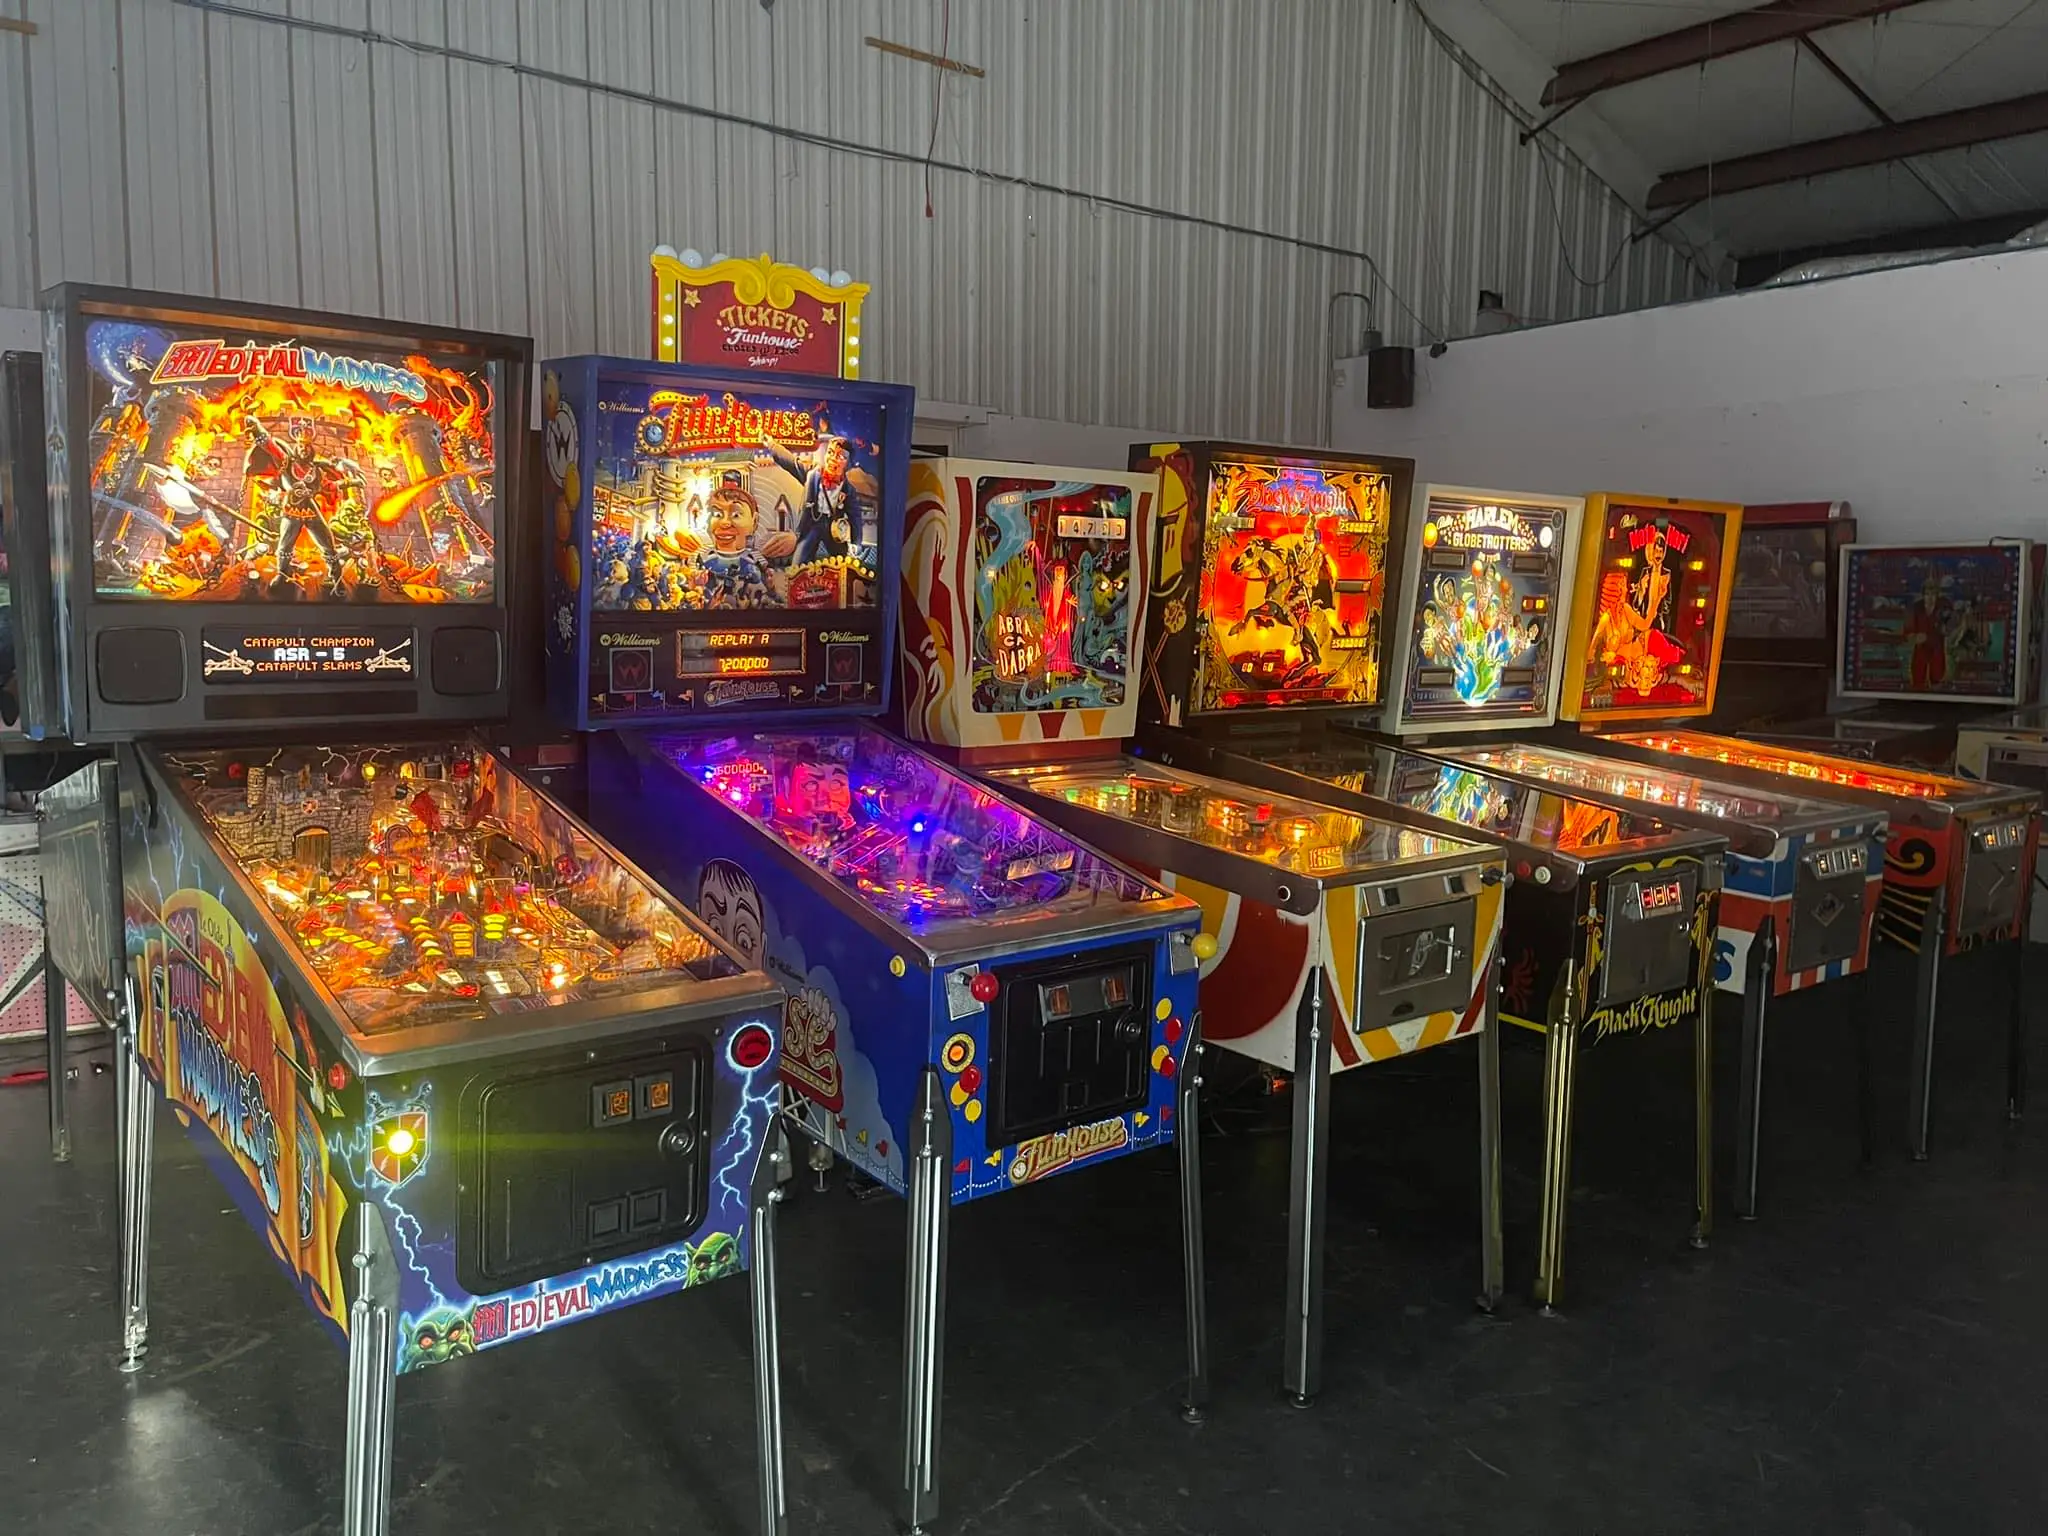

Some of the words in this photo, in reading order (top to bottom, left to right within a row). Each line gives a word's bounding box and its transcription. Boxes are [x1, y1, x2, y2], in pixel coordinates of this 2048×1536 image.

[720, 305, 808, 338] TICKETS
[151, 338, 307, 384] MEDIEVAL
[301, 346, 427, 401] MADNESS
[1465, 506, 1519, 536] HARLEM
[998, 614, 1033, 637] ABRA
[243, 637, 306, 647] CATAPULT
[311, 637, 375, 647] CHAMPION
[612, 633, 661, 647] Williams
[710, 634, 754, 646] REPLAY
[829, 630, 869, 643] Williams
[1003, 635, 1026, 647] CA
[256, 661, 313, 672] CATAPULT
[323, 661, 363, 671] SLAMS
[998, 643, 1042, 677] DABRA
[472, 1282, 592, 1344] MEDIEVAL
[586, 1253, 688, 1309] MADNESS
